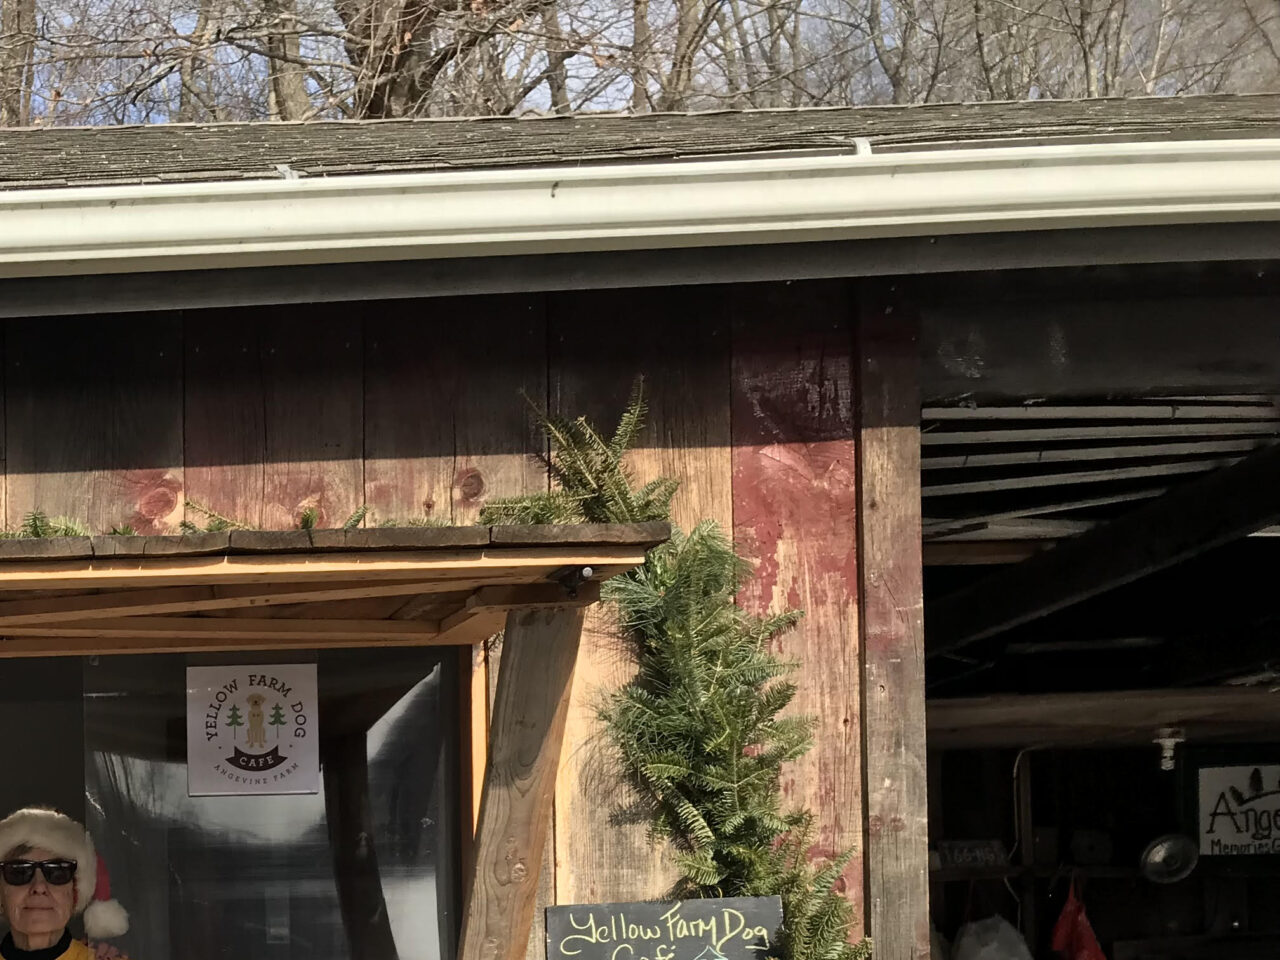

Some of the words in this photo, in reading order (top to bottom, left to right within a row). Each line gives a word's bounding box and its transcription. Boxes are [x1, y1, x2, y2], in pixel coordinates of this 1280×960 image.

[206, 679, 239, 742] YELLOW
[248, 674, 292, 698] FARM
[291, 701, 307, 739] DOG
[214, 764, 268, 785] ANGEVINE
[273, 762, 300, 782] FARM
[239, 755, 274, 768] CAFE
[560, 912, 661, 956] Yellow
[715, 907, 771, 957] Dog
